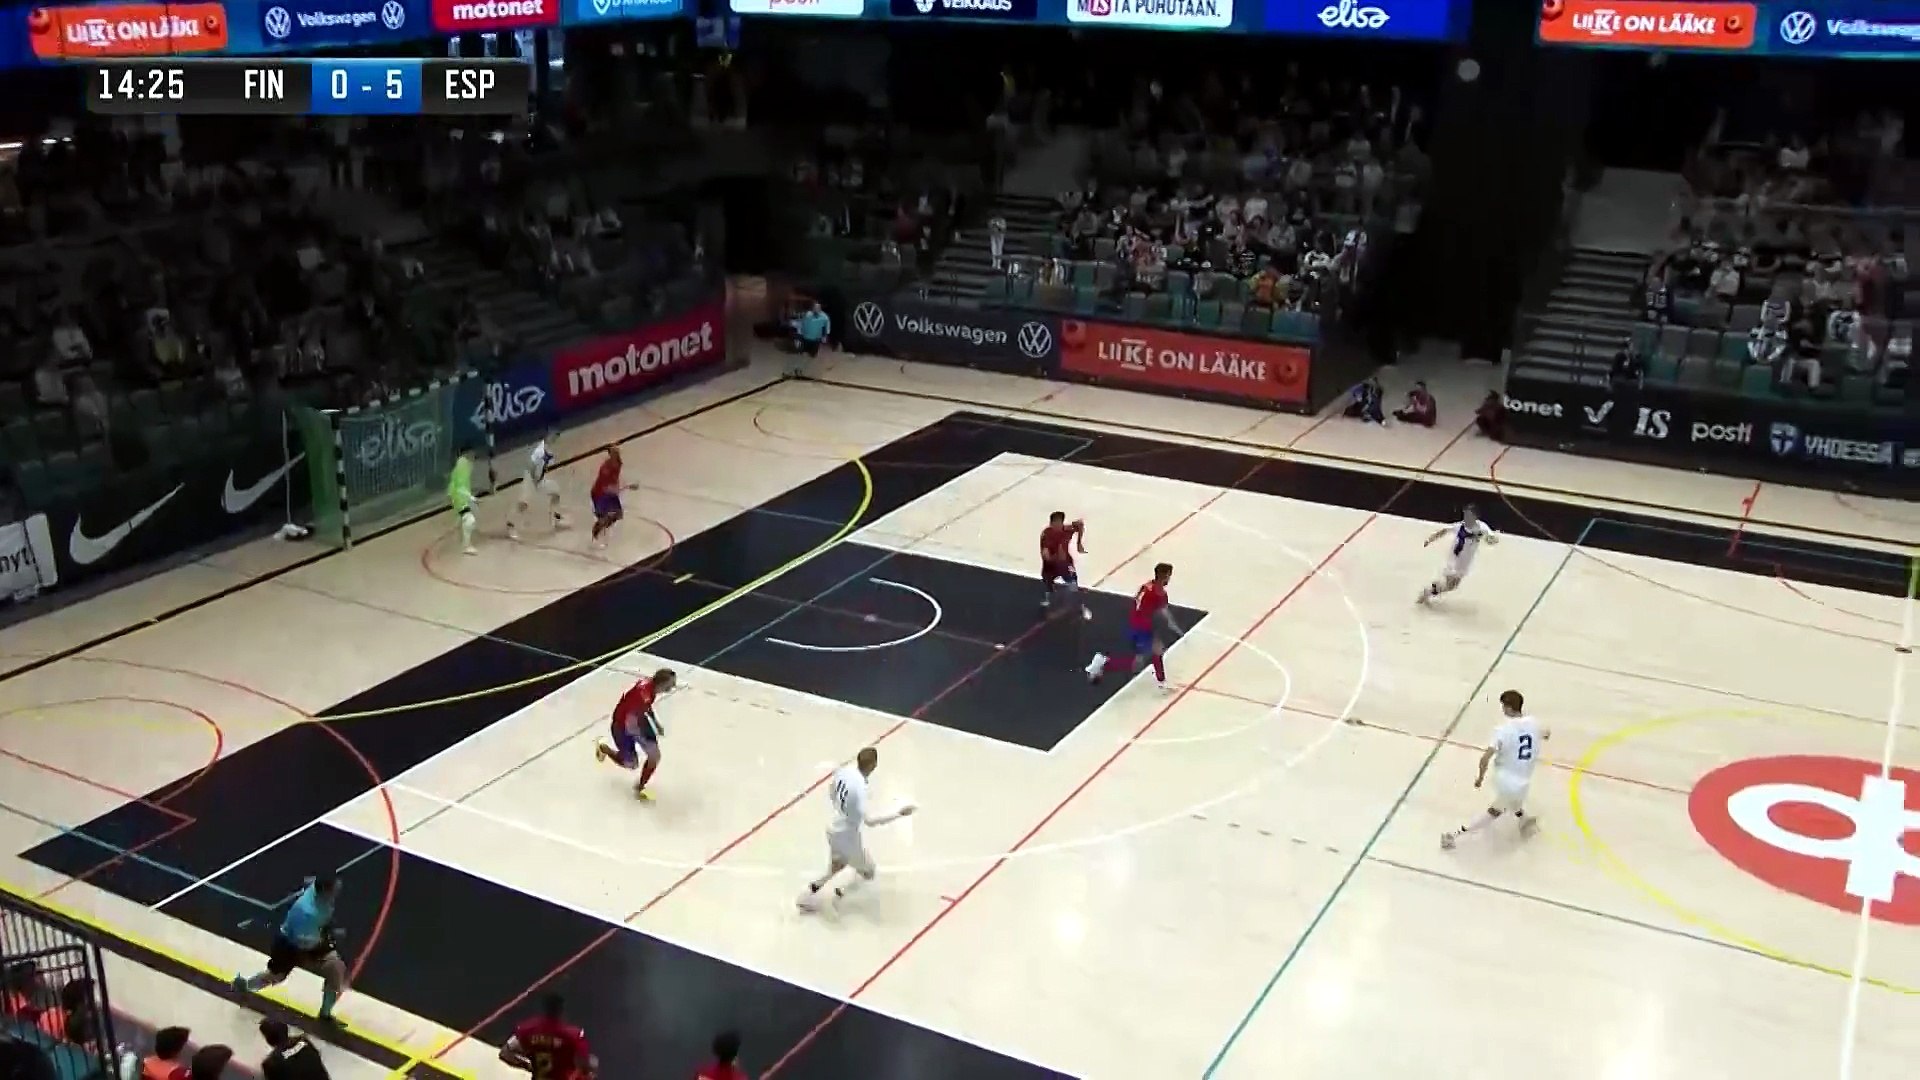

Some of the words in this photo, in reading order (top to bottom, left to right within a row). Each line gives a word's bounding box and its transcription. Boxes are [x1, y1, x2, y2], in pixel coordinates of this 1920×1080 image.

[297, 11, 377, 27] Volkswagen
[452, 0, 544, 20] motonet
[1317, 0, 1391, 28] elisa
[117, 20, 148, 40] ON
[1624, 16, 1656, 33] ON
[895, 312, 1008, 345] Volkswagen
[567, 320, 714, 397] motonet
[1159, 350, 1194, 371] ON
[1198, 351, 1267, 381] LÄÄKE
[1633, 406, 1672, 440] IS
[356, 413, 440, 466] elisa
[1517, 733, 1532, 761] 2
